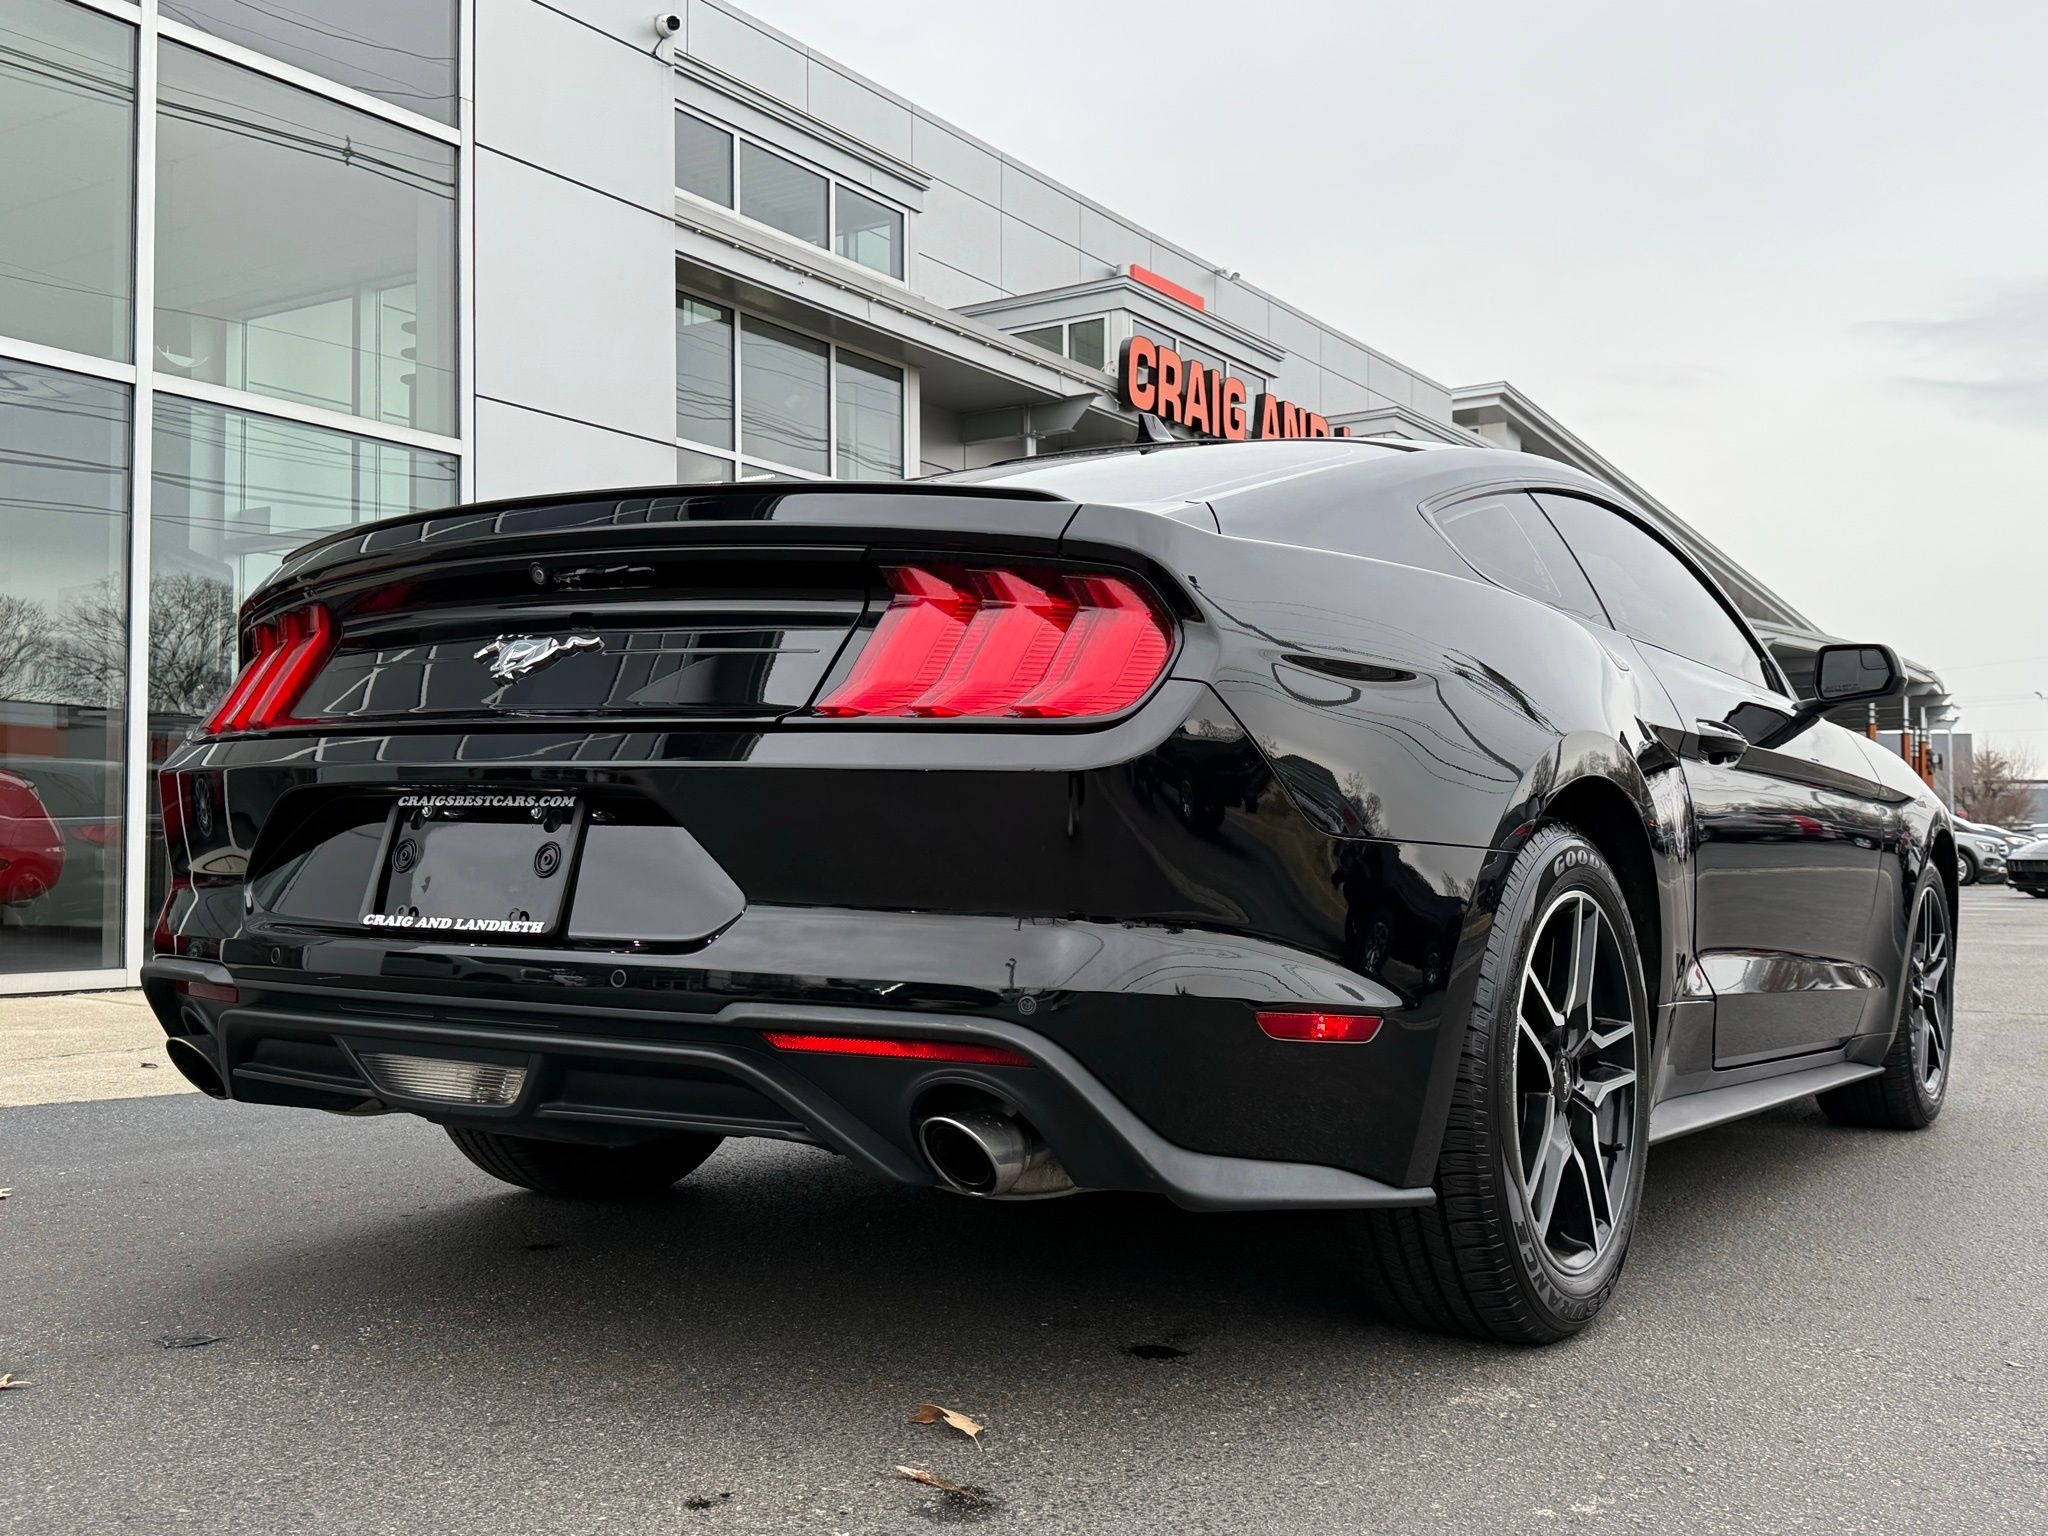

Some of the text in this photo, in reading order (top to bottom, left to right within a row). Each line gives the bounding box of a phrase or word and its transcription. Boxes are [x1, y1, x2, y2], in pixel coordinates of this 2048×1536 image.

[1120, 335, 1246, 441] CRAIG
[398, 795, 577, 807] CRAIGSBESTCARS.COM
[363, 914, 545, 933] CRAIG AND LANDRETH
